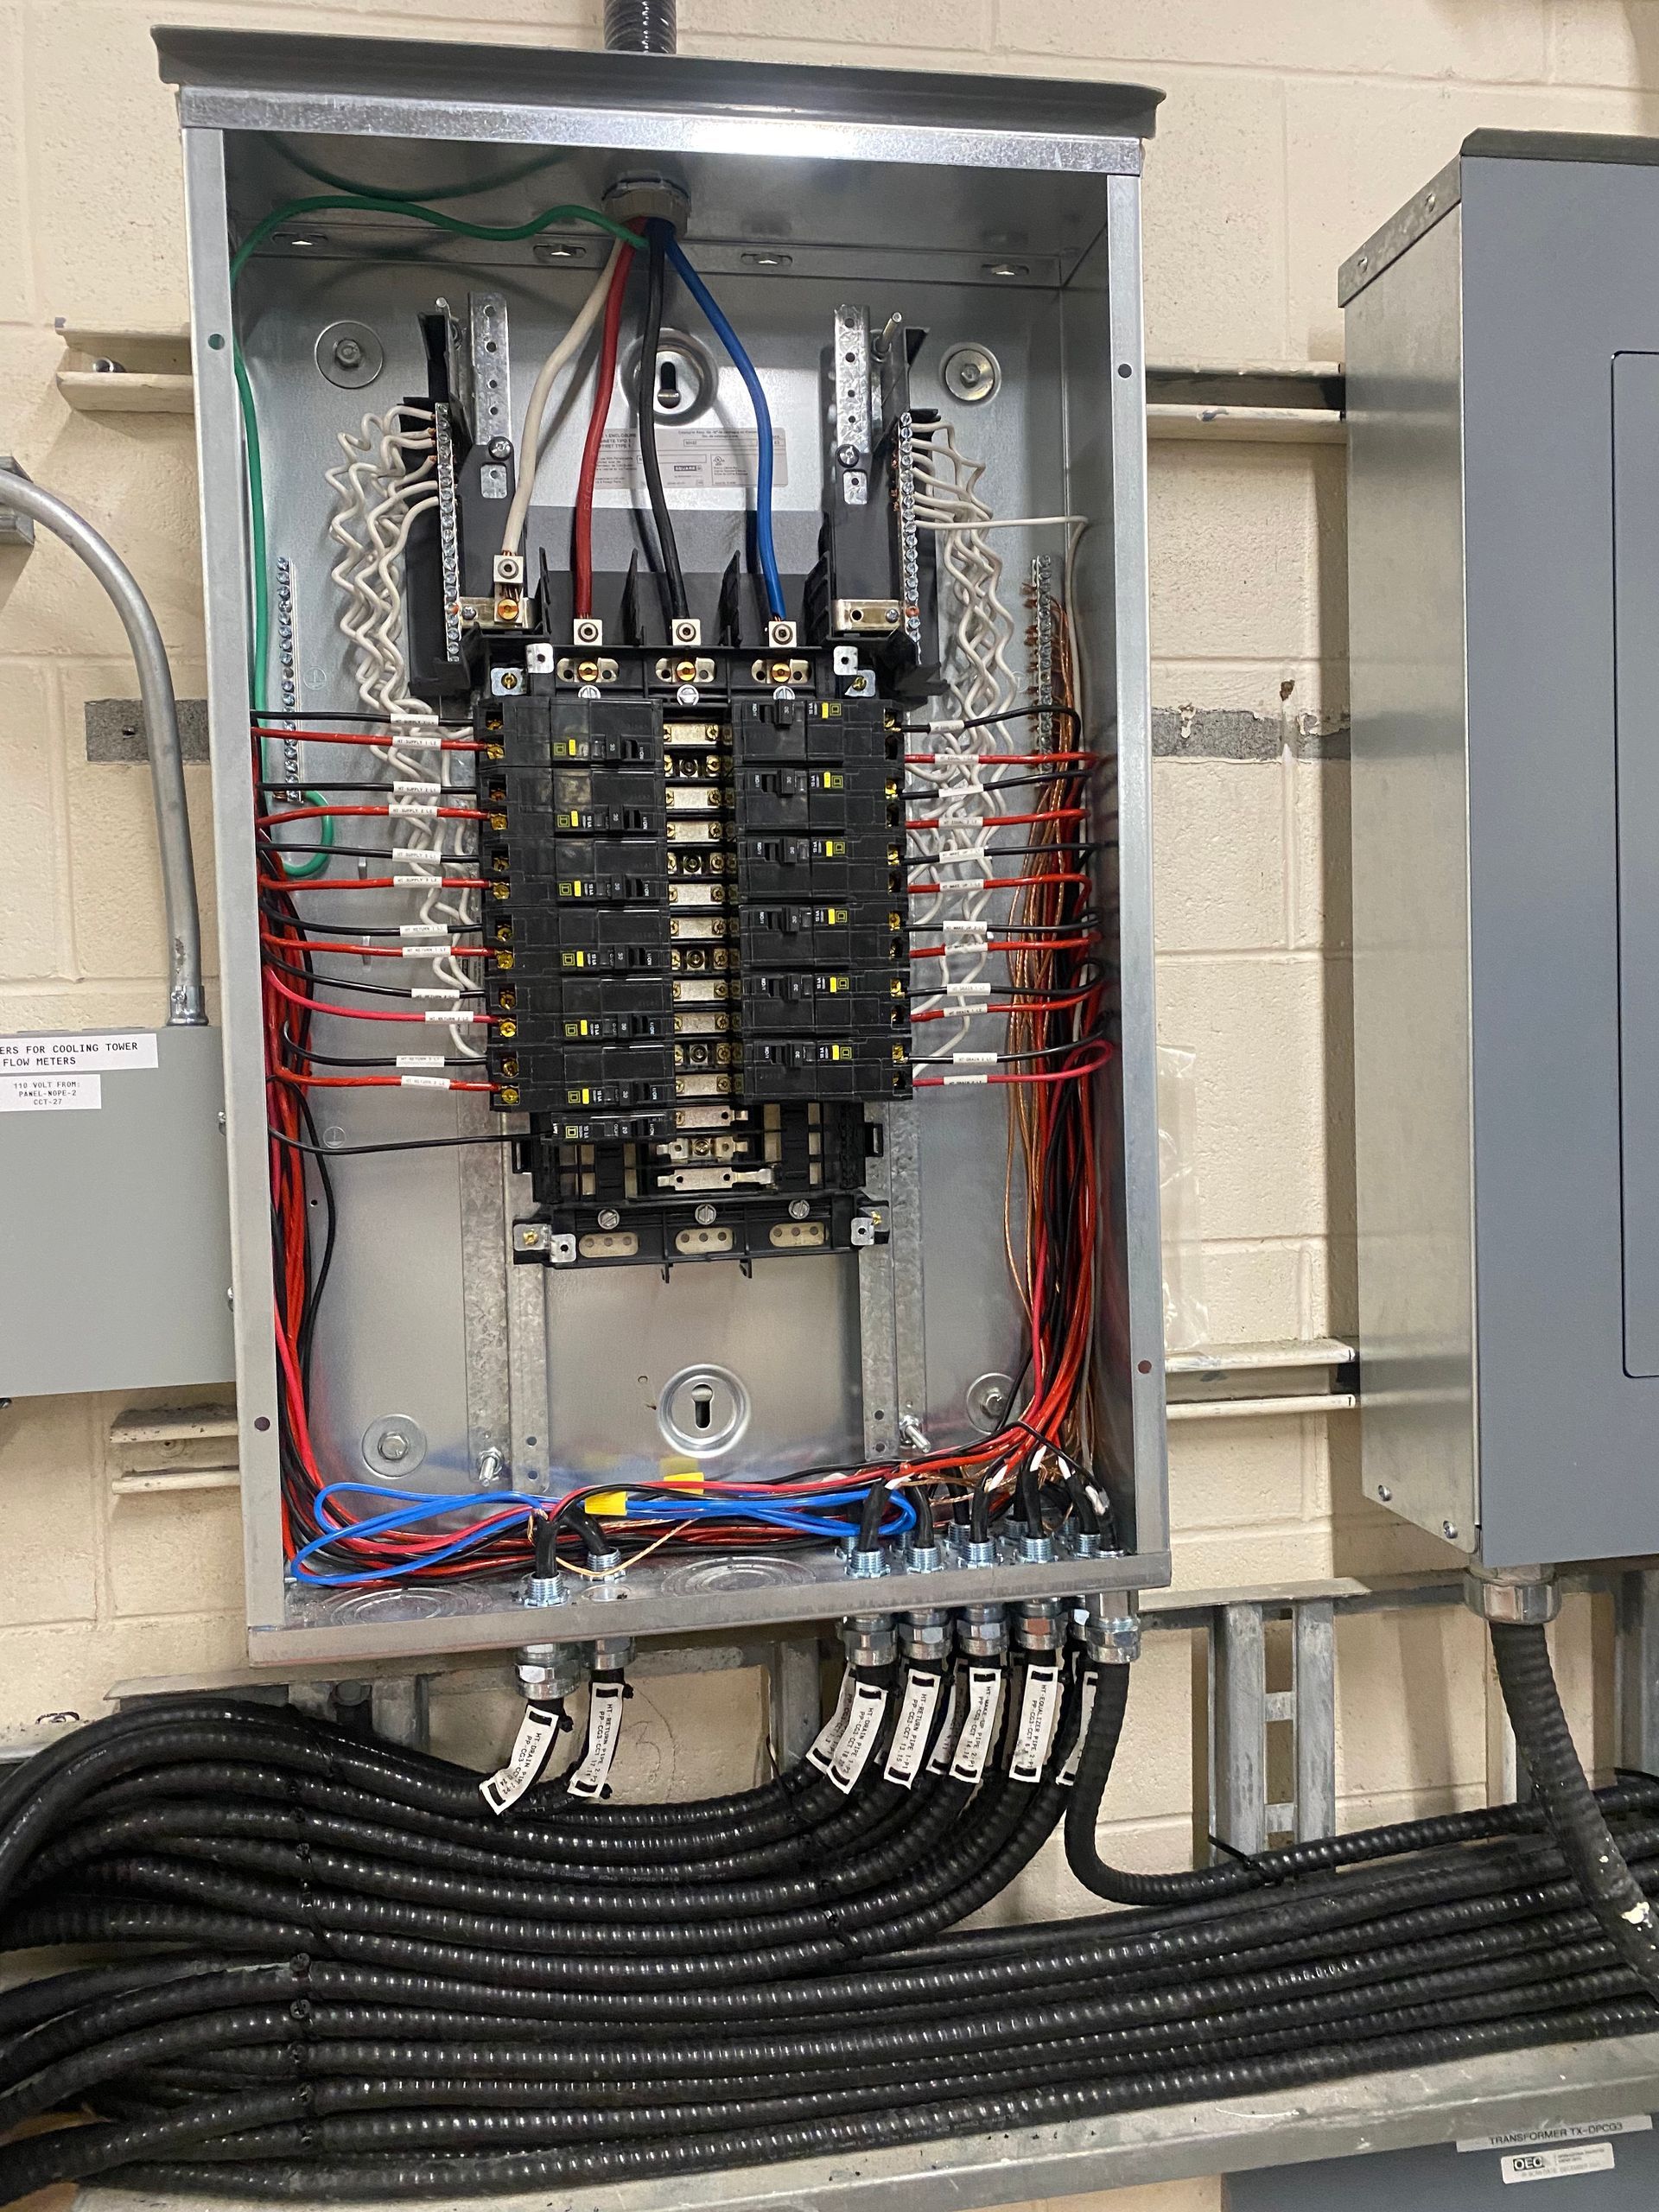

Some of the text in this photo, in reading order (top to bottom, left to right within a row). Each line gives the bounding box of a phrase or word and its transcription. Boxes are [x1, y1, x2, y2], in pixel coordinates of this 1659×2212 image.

[0, 1046, 18, 1055] ERS
[53, 1044, 99, 1053] COOLING
[106, 1042, 138, 1051] TOWER
[3, 1057, 76, 1067] FLOW METERS
[913, 1694, 927, 1731] HT-RETURN
[1035, 1685, 1046, 1732] HT-EQUALIZER
[908, 1734, 917, 1750] PIPE
[974, 1732, 982, 1748] PIPE
[1490, 2122, 1623, 2145] TRANSFORMER TX-DPCG3
